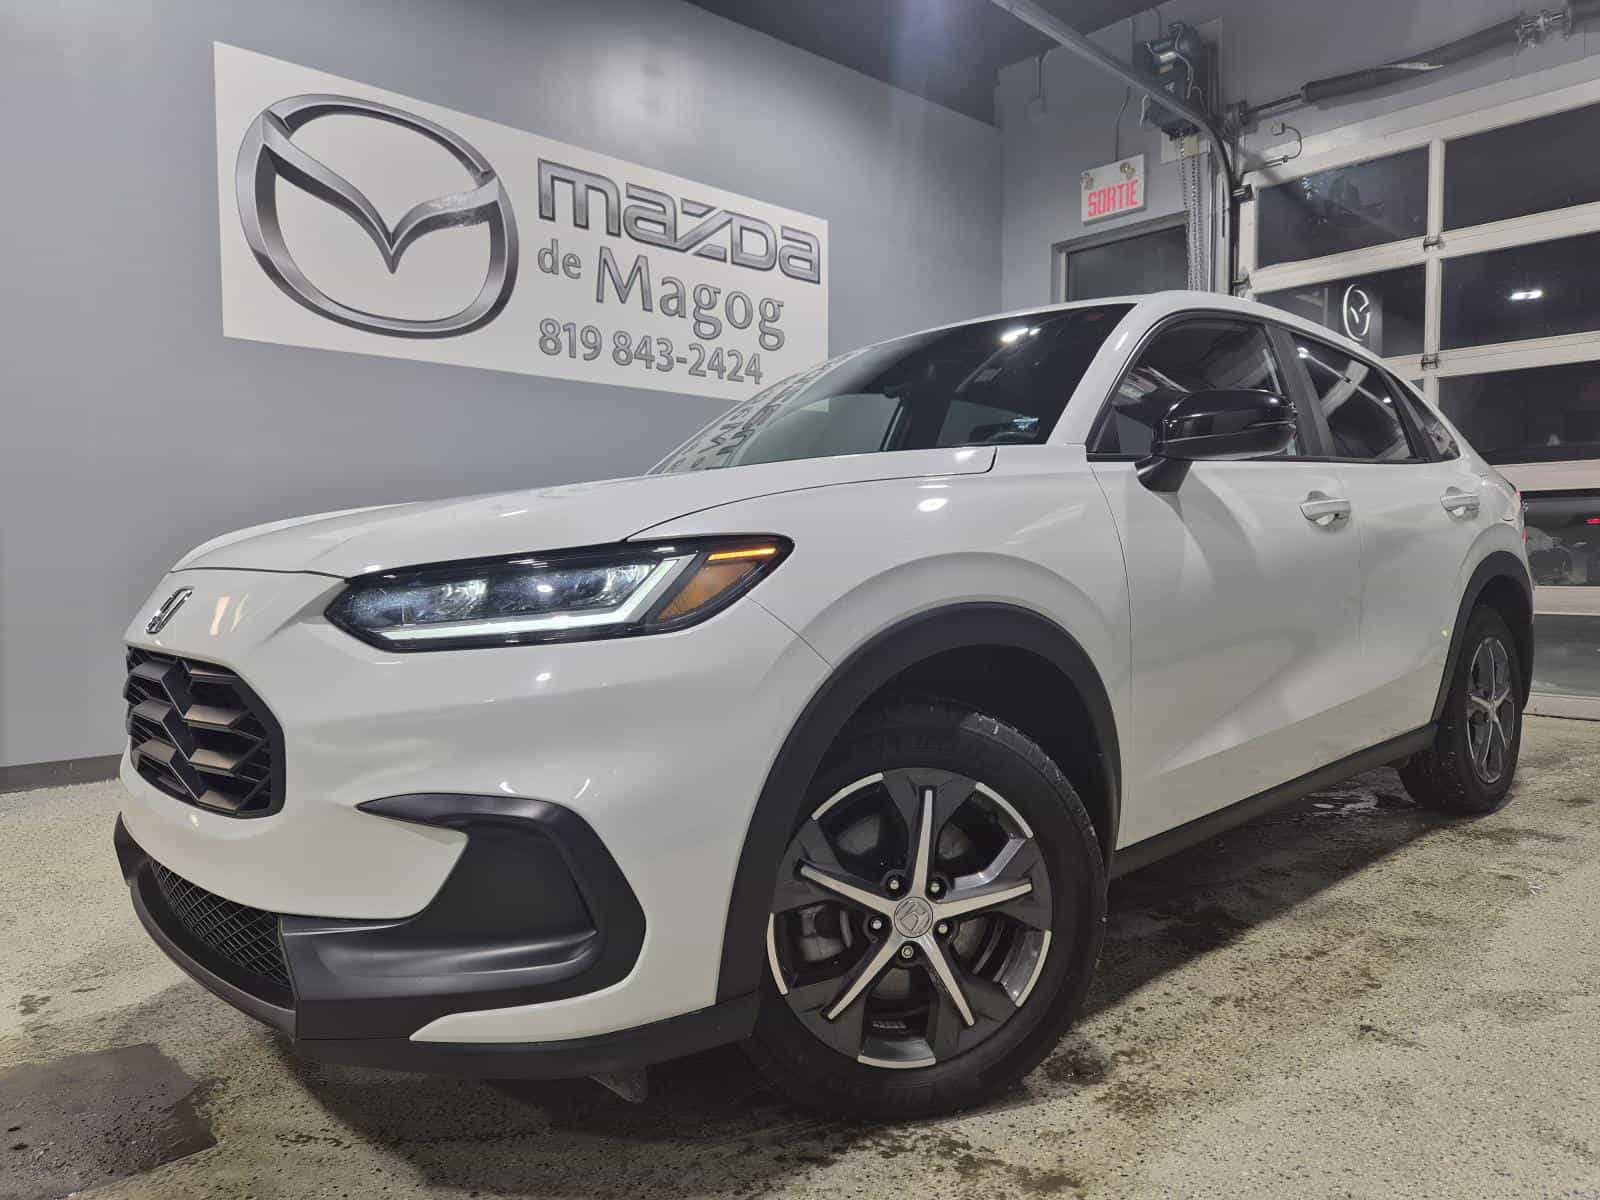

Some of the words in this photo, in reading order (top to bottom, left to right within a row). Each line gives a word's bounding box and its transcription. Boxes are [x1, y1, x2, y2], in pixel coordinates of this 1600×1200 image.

[1087, 179, 1139, 217] SORTIE
[537, 239, 582, 279] de
[595, 246, 786, 351] Magog
[538, 318, 602, 361] 819
[612, 331, 763, 385] 843-2424
